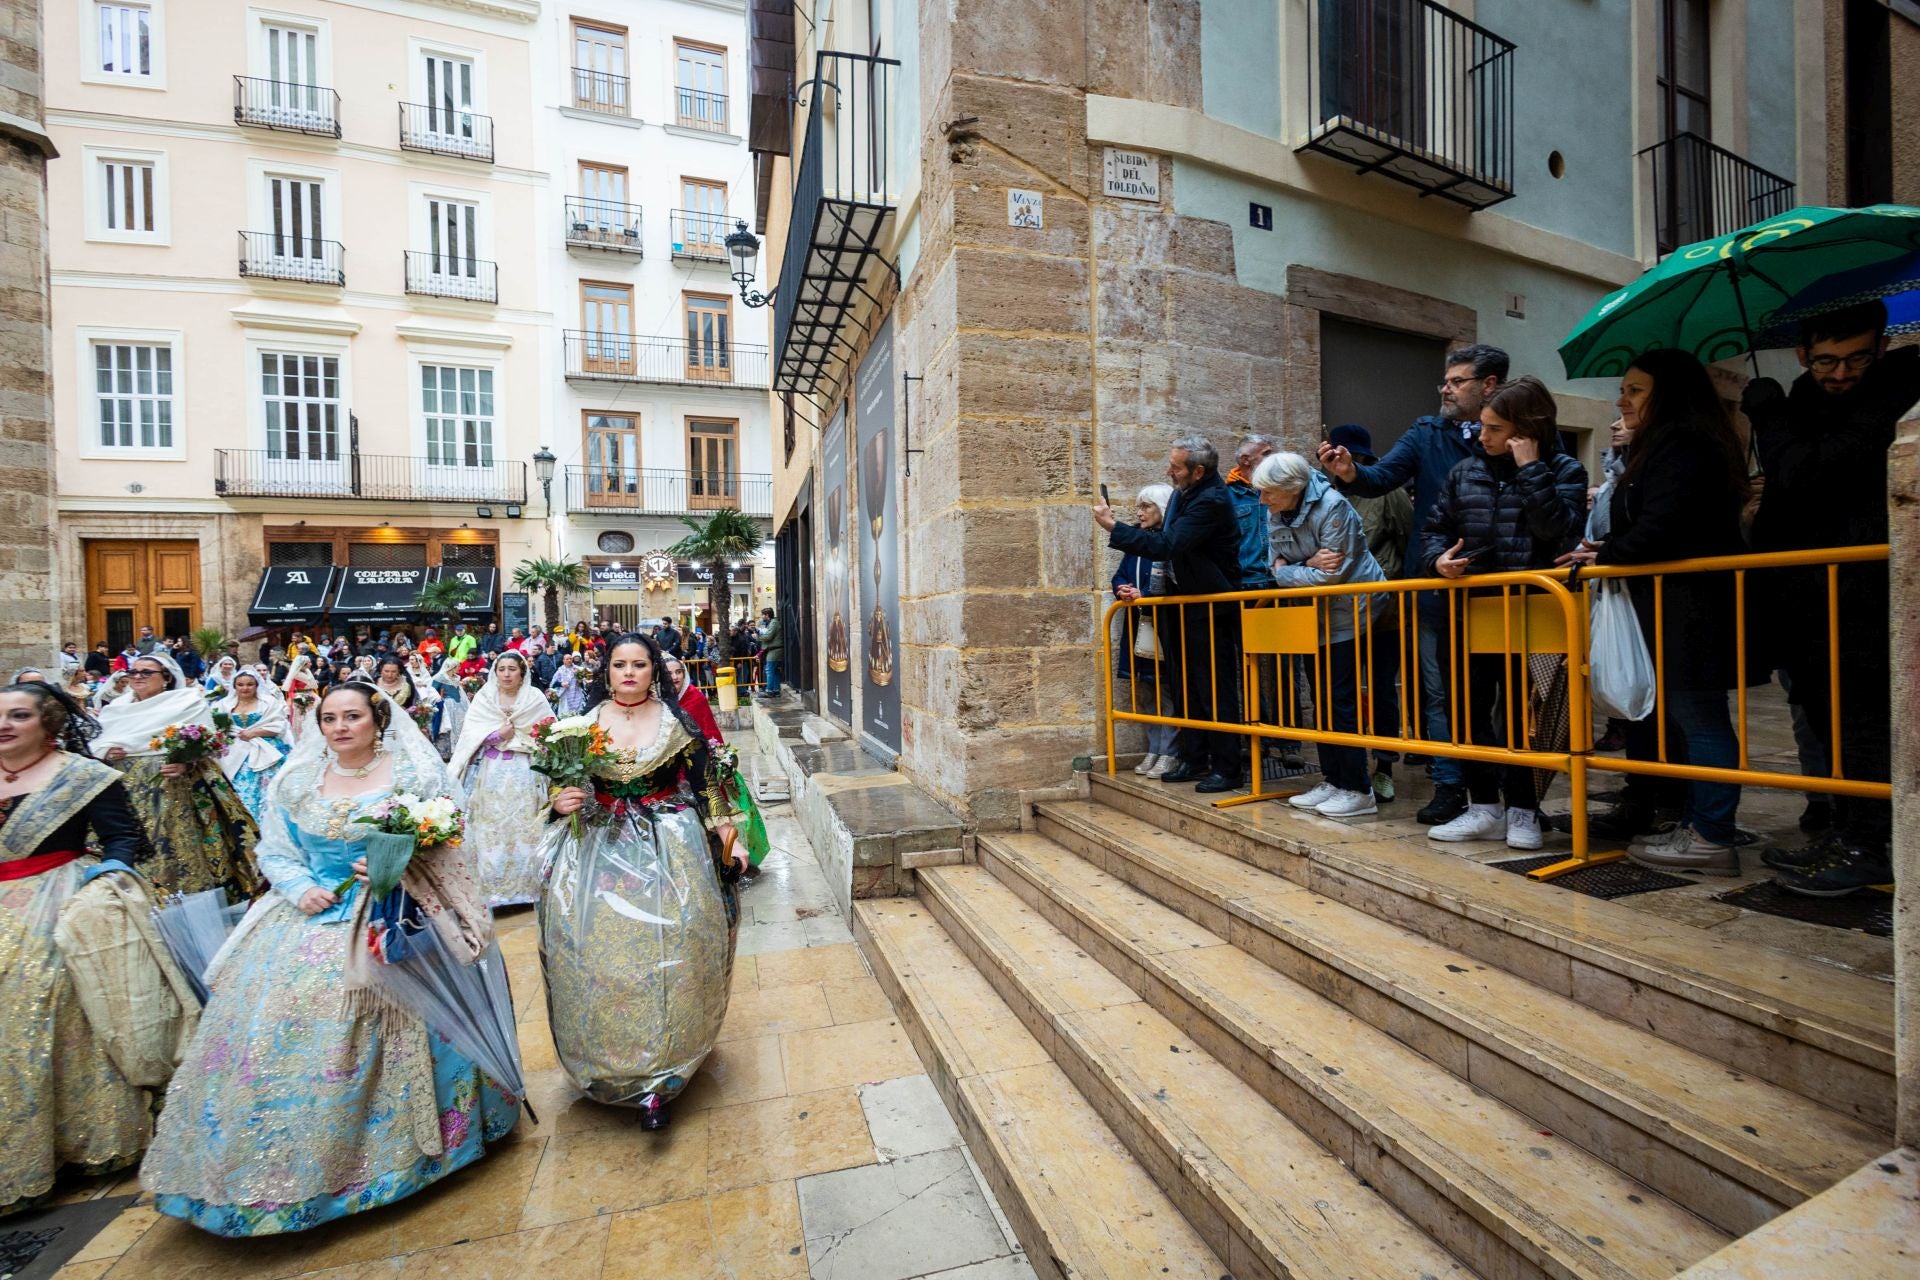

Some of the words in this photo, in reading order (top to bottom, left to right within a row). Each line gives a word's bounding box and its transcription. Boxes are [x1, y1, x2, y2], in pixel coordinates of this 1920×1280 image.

[1114, 154, 1147, 167] SUBIDA
[1123, 169, 1141, 180] DEL
[1257, 208, 1264, 225] 1
[595, 568, 636, 579] véneta
[697, 569, 734, 579] véa
